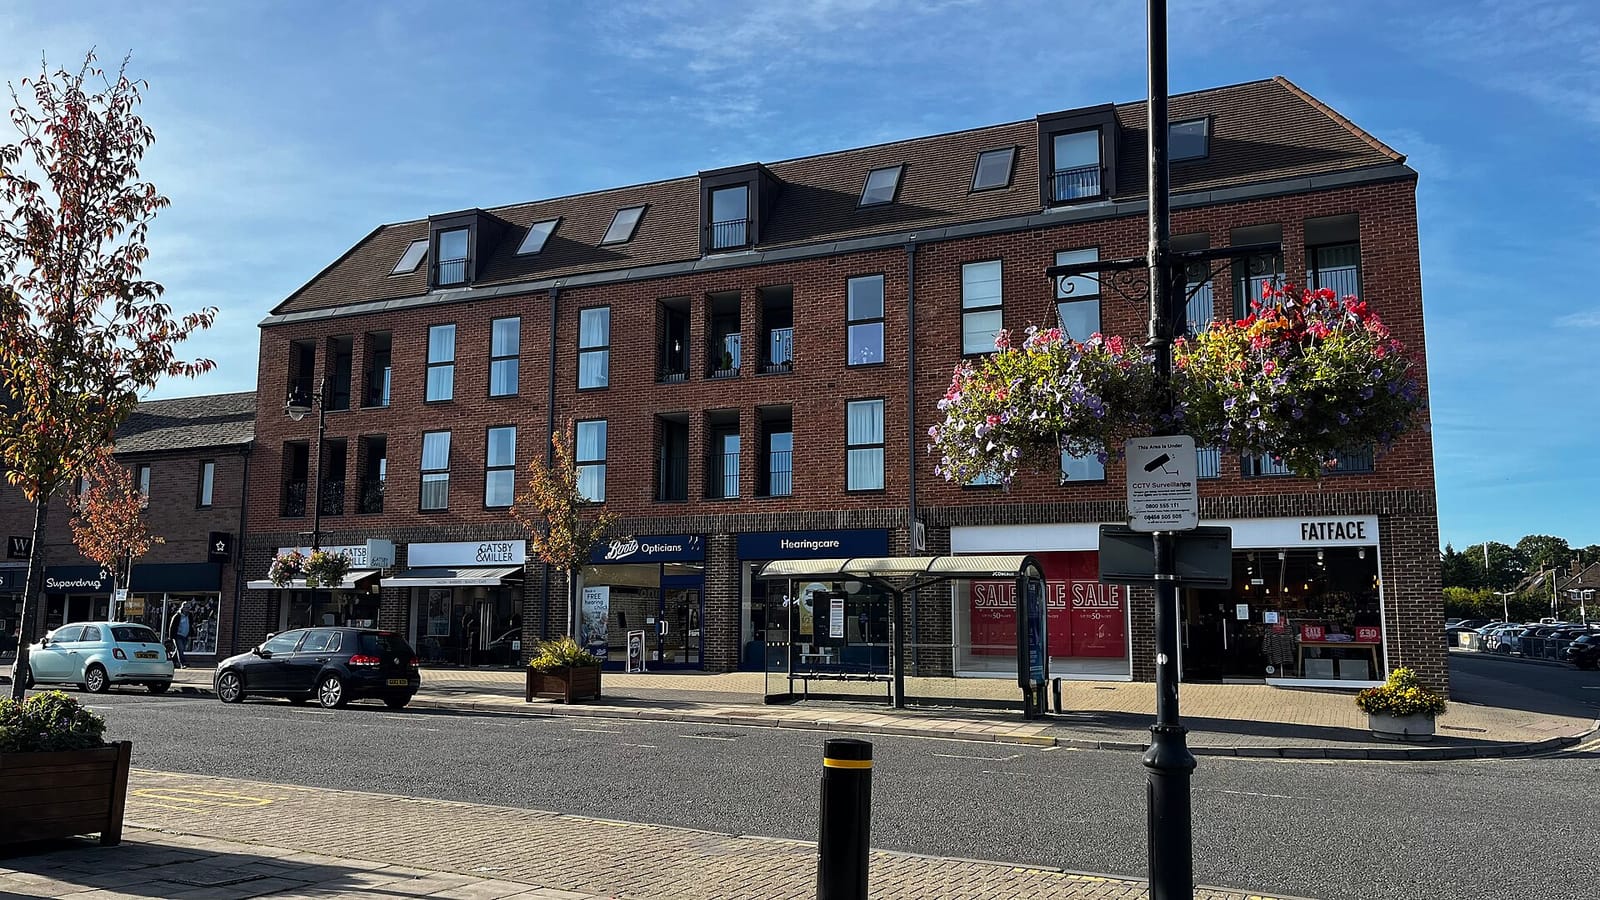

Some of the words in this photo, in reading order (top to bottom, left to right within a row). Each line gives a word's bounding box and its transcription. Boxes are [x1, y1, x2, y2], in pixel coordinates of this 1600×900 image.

[1300, 521, 1367, 541] FATFACE
[13, 539, 29, 551] W
[479, 543, 513, 553] GATSBY
[604, 539, 639, 560] Boots
[641, 543, 682, 555] Opticians
[781, 538, 840, 550] Hearingcare
[341, 547, 367, 557] GATSB
[483, 552, 513, 562] MILLER
[46, 577, 102, 590] Superdrug
[974, 584, 1016, 606] SALE
[1045, 584, 1066, 606] LE
[1071, 583, 1119, 607] SALE
[1359, 628, 1377, 638] £30
